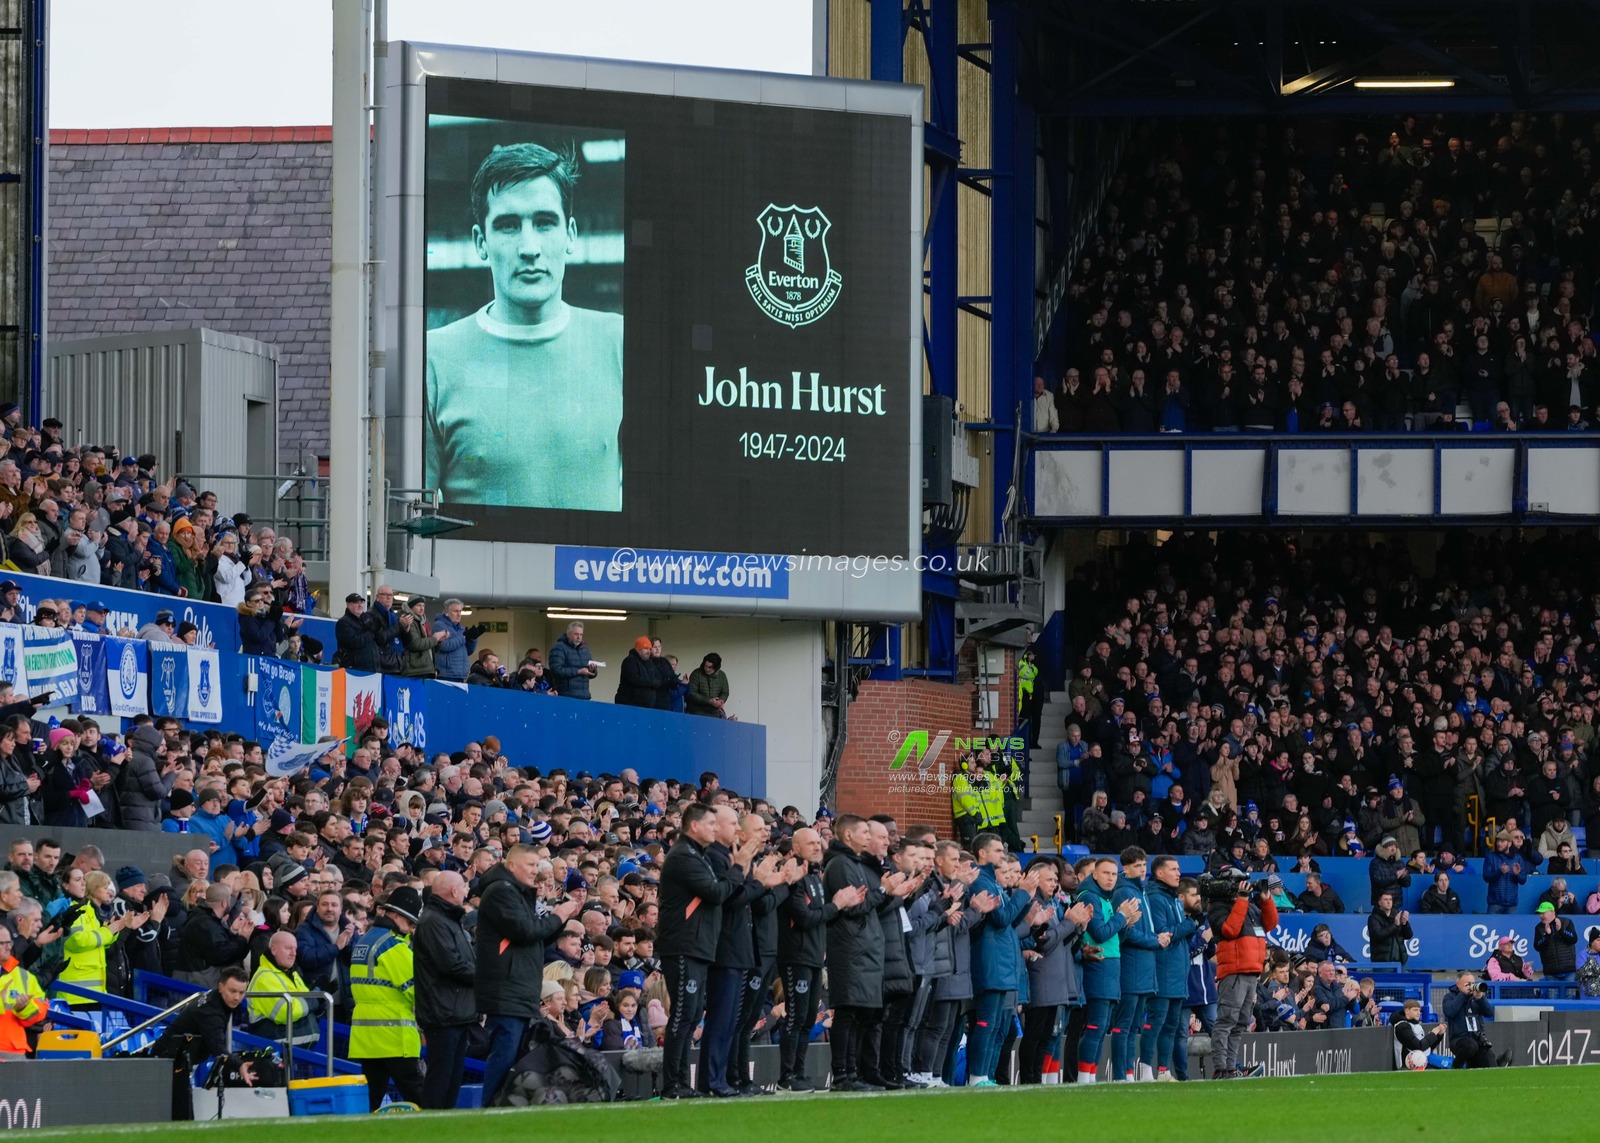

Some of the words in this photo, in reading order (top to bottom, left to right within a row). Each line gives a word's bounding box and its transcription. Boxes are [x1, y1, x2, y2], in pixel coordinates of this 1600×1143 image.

[768, 270, 819, 289] Everton
[751, 283, 762, 301] NIL
[762, 299, 783, 319] SATIS
[785, 313, 803, 322] NISI
[805, 288, 836, 320] OPTIMUM
[785, 291, 802, 301] 1878
[698, 366, 783, 410] John
[791, 371, 887, 416] Hurst
[738, 432, 847, 463] 1947-2024
[573, 556, 772, 589] evertonfc.com
